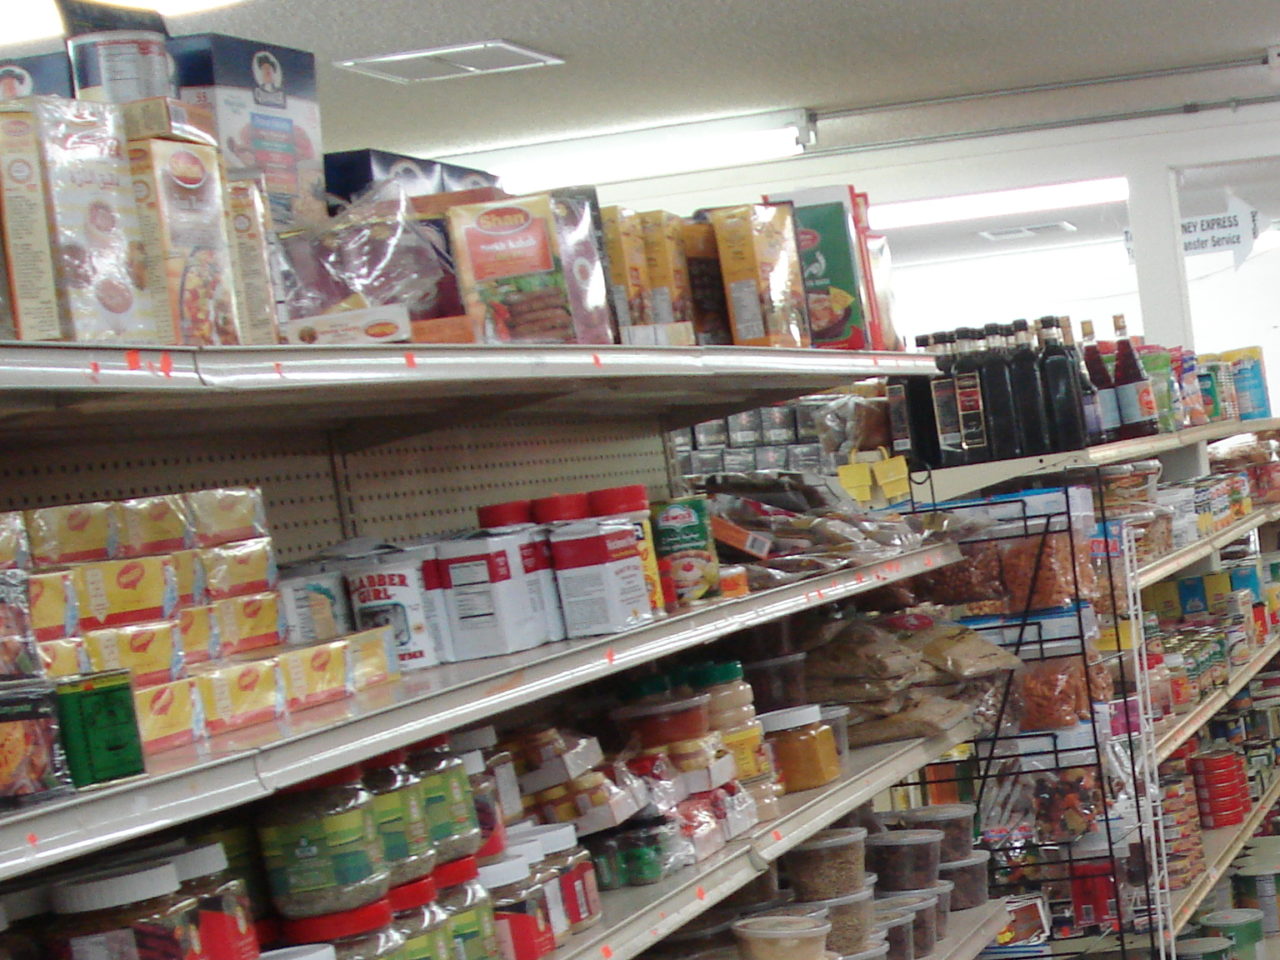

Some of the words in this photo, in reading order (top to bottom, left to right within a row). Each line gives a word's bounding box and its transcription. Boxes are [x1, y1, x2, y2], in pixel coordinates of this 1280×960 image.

[1200, 215, 1240, 232] EXPRESS
[1211, 234, 1241, 248] Service
[358, 587, 392, 604] GIRL
